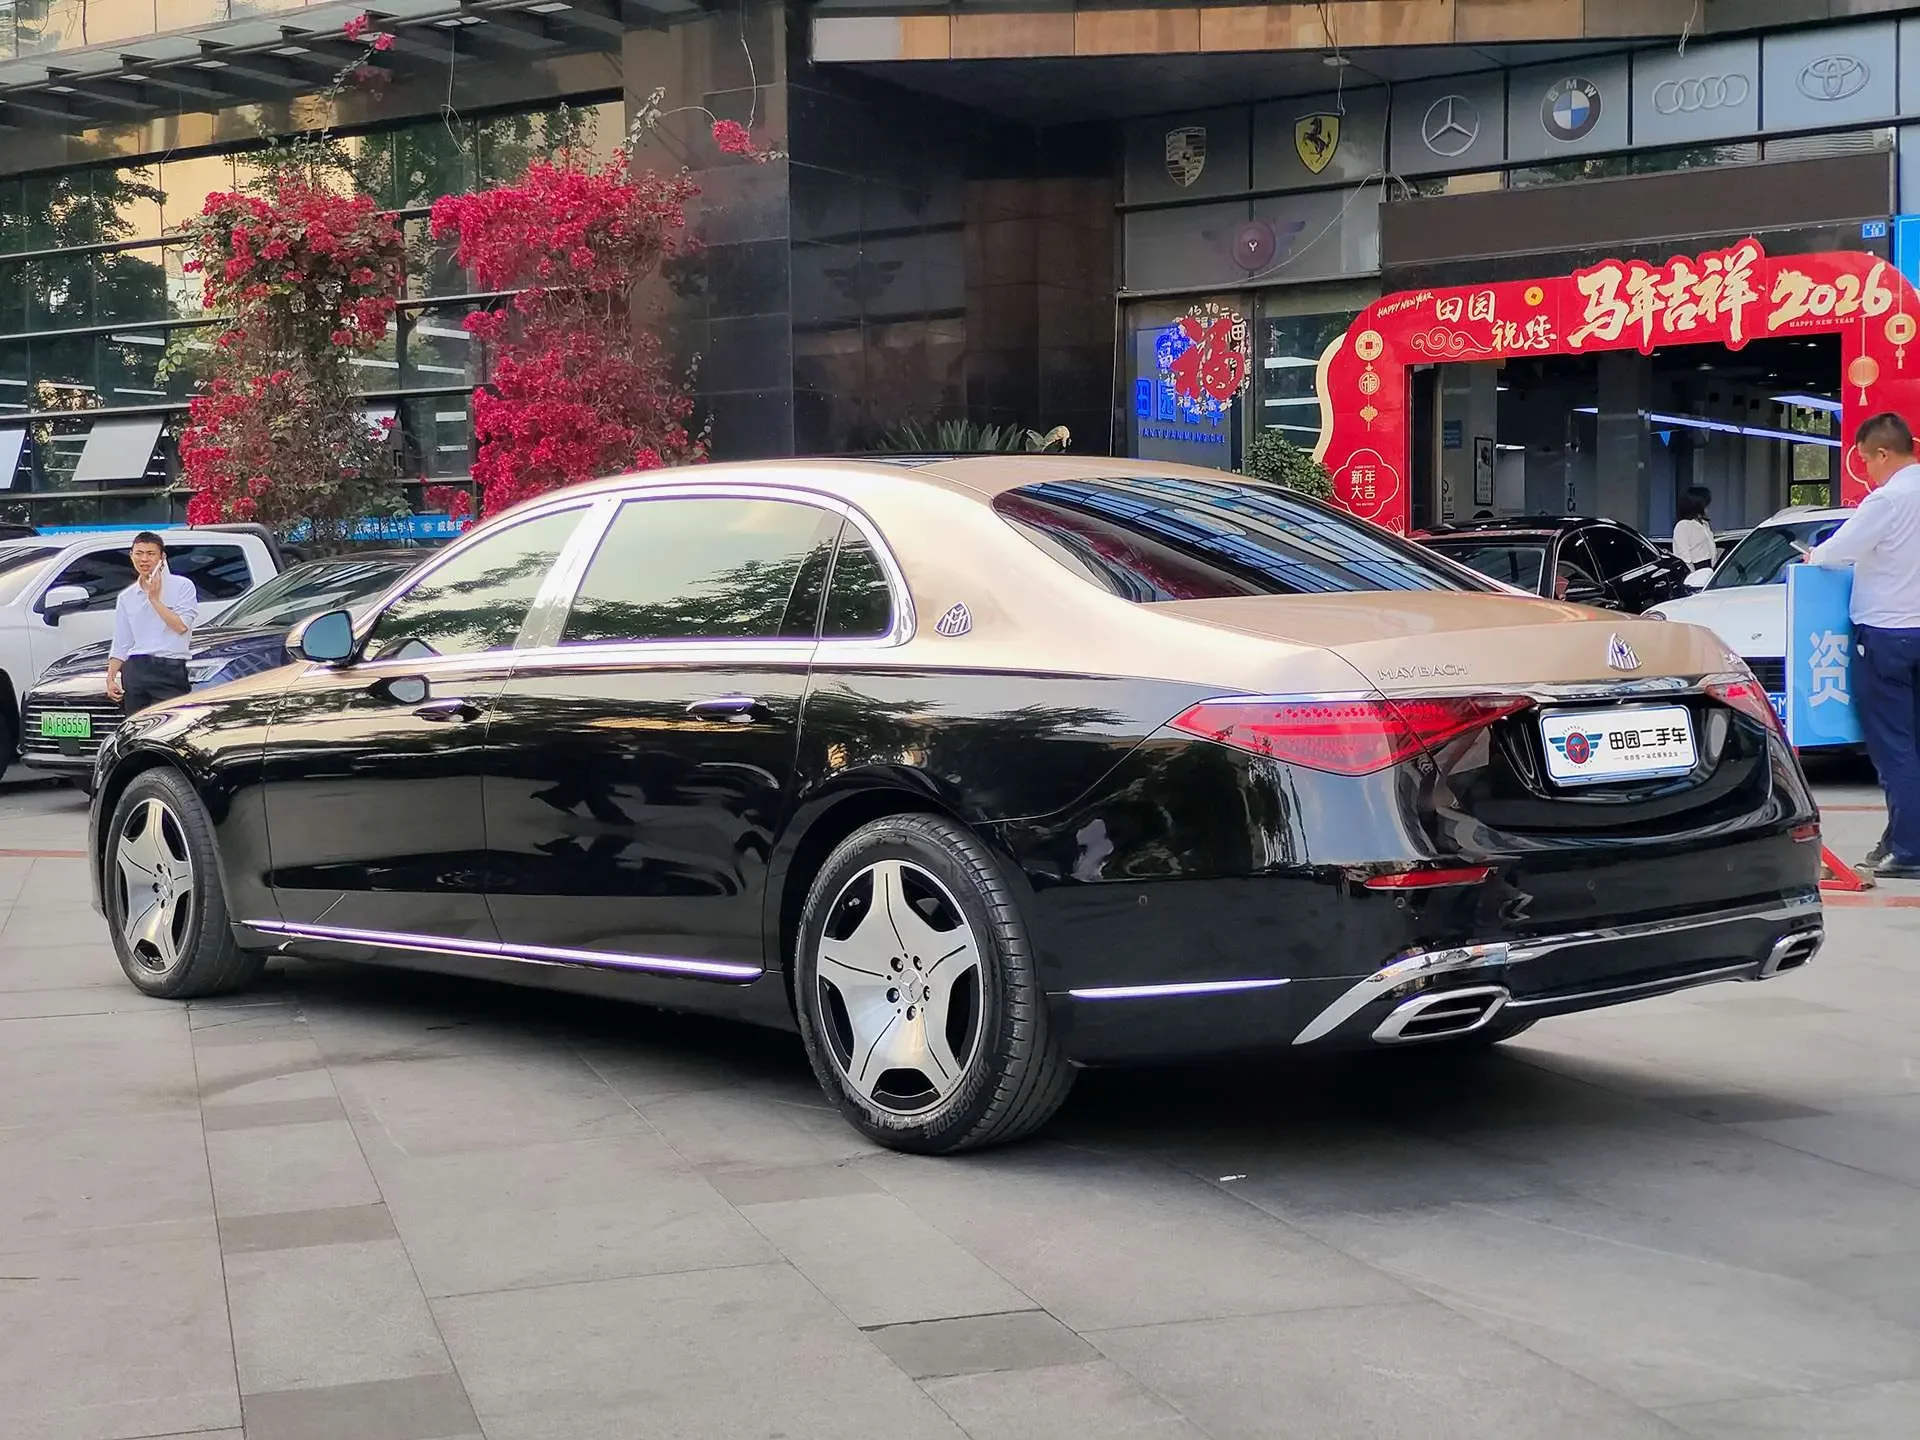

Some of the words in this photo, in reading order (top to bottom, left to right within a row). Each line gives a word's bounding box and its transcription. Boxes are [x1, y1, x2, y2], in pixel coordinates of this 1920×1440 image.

[1547, 79, 1597, 102] BMW
[1435, 290, 1496, 323] 田园
[1567, 245, 1761, 348] 马年吉祥
[1768, 261, 1893, 332] 2026
[1377, 302, 1401, 318] HAPPY
[1491, 314, 1557, 352] 祝您
[1789, 320, 1814, 328] HAPPY
[1835, 316, 1855, 324] YEAR
[1351, 469, 1376, 484] 新年
[1350, 484, 1376, 499] 大吉
[1377, 663, 1468, 680] MAYBACH
[1808, 630, 1850, 708] 资
[1608, 727, 1688, 750] 田园二手车
